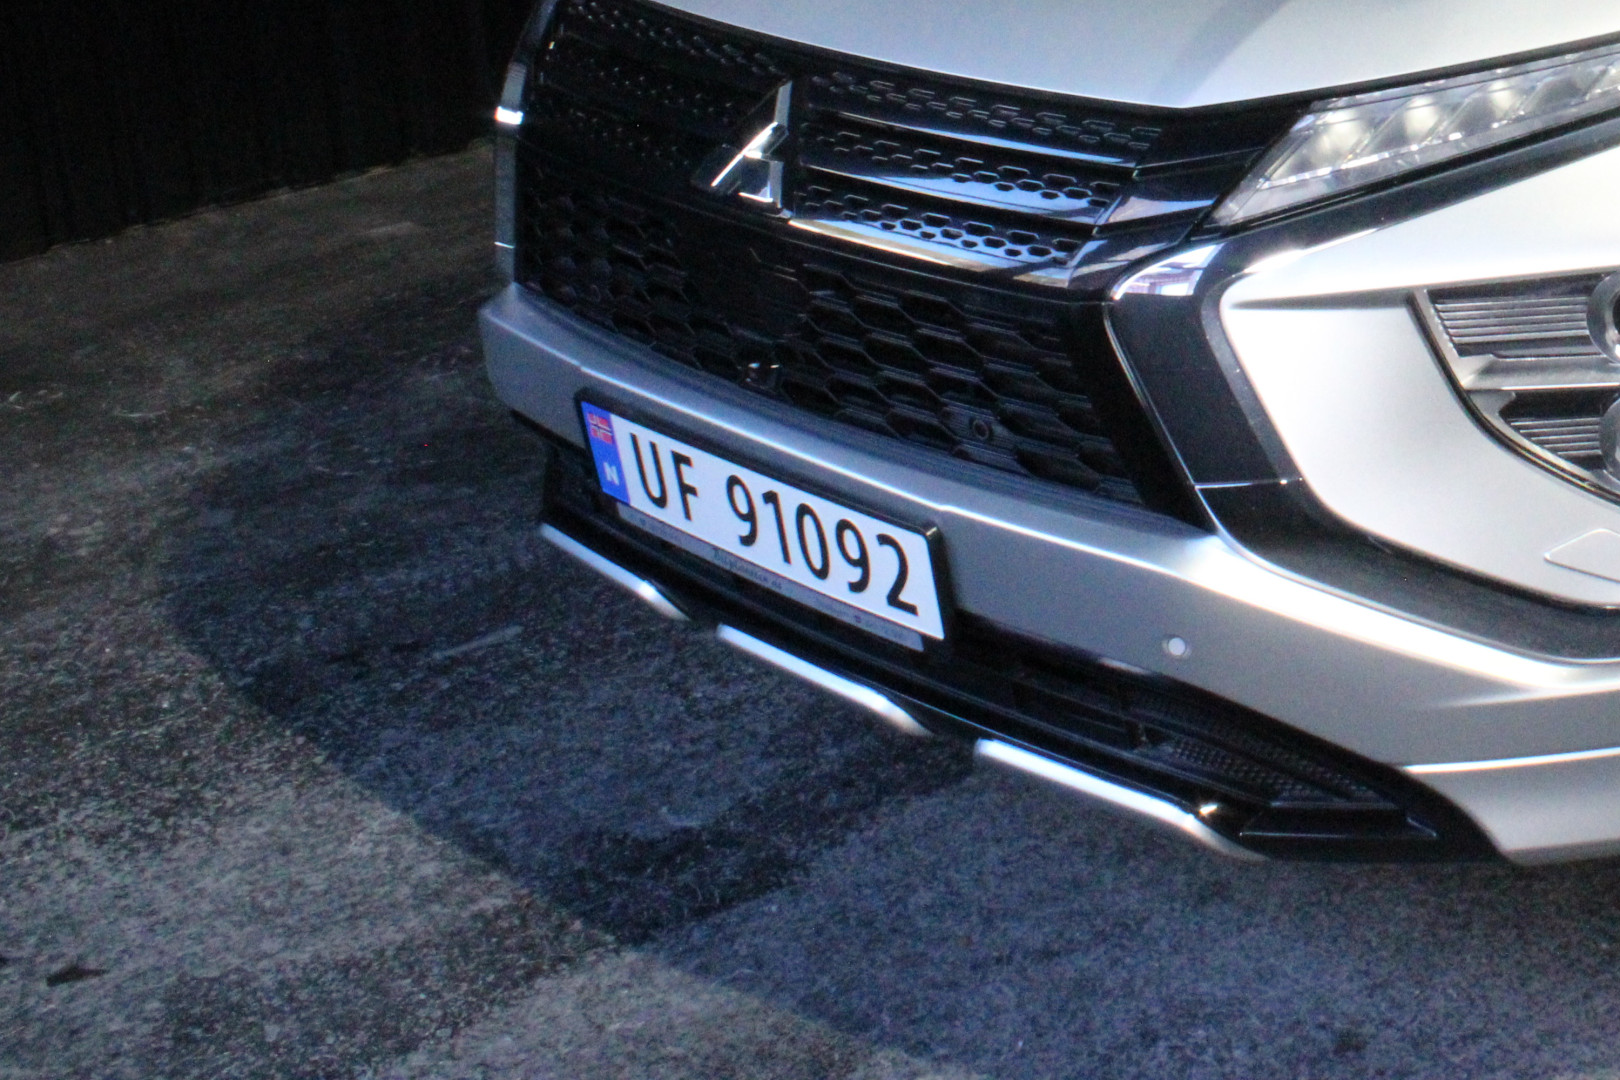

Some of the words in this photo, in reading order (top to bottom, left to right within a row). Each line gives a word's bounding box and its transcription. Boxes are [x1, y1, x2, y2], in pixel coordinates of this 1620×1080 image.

[603, 461, 620, 487] N
[630, 431, 699, 522] UF
[725, 474, 921, 617] 91092
